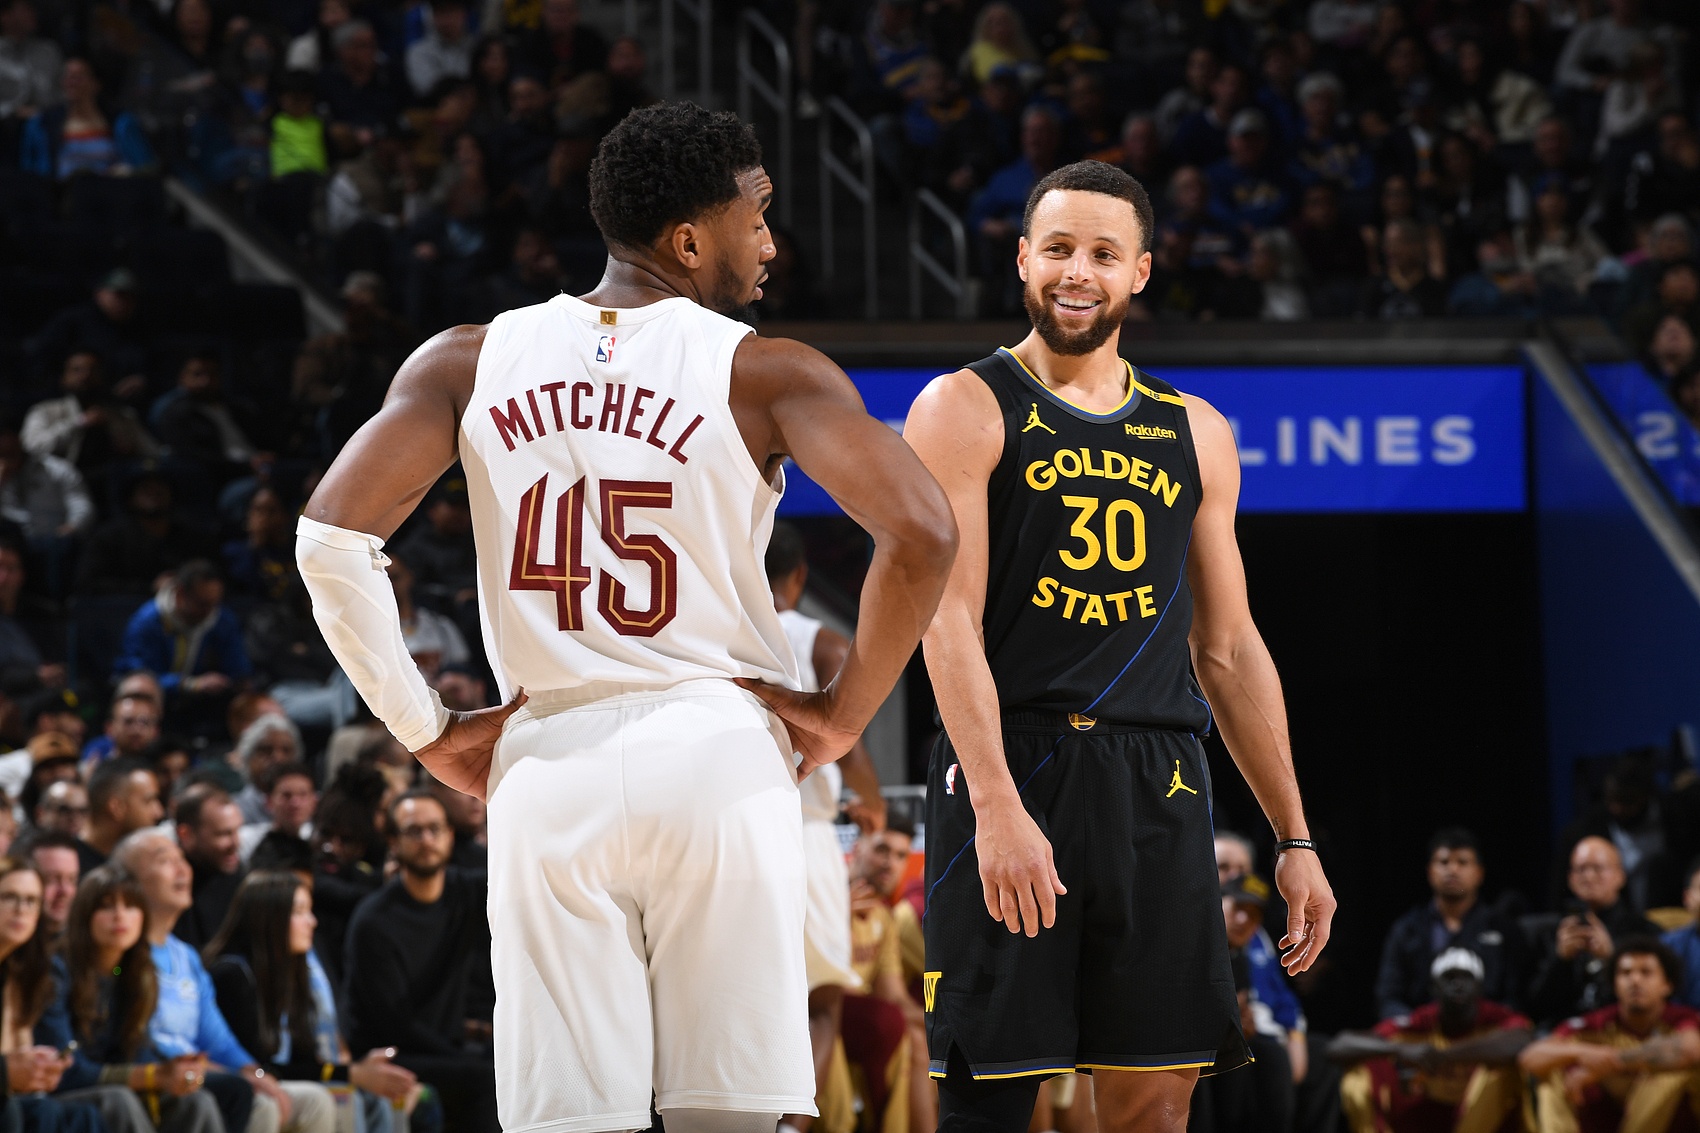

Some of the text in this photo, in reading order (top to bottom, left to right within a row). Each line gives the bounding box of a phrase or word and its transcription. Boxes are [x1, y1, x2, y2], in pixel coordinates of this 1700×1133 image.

[489, 381, 705, 465] MITCHELL
[1124, 423, 1177, 439] Rakuten
[1231, 416, 1477, 466] LINES
[1025, 448, 1182, 508] GOLDEN
[509, 472, 677, 637] 45
[1058, 495, 1146, 572] 30
[1031, 577, 1157, 626] STATE
